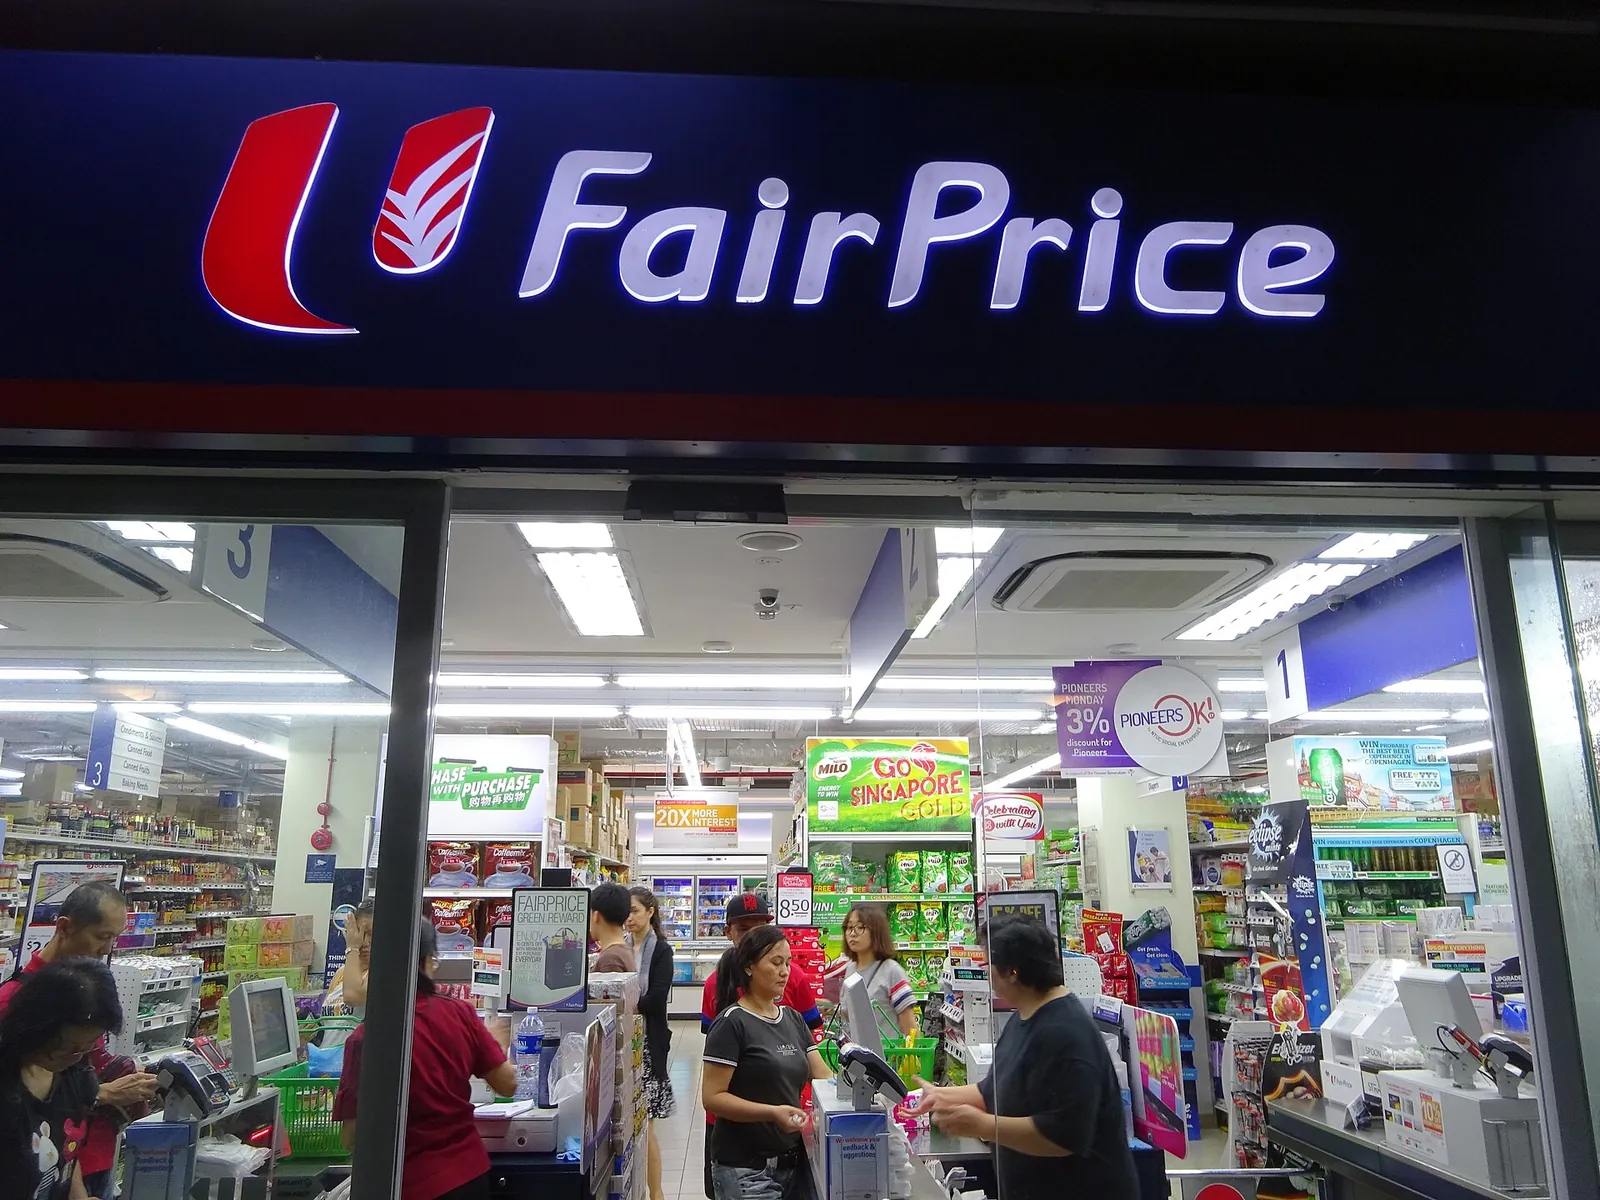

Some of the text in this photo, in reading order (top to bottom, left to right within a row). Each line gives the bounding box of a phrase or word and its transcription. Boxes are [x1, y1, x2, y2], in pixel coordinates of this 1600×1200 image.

[518, 149, 1336, 317] FairPrice
[1277, 649, 1291, 699] 1
[1062, 683, 1108, 694] PIONEERS
[1065, 695, 1105, 705] MONDAY
[1067, 707, 1110, 735] 3%
[1120, 707, 1184, 728] PIONEERS
[1066, 738, 1112, 748] discount for
[1359, 740, 1379, 748] WIN
[127, 744, 152, 758] Canned Food
[1074, 748, 1108, 757] Pioneers
[123, 760, 138, 773] Canned
[818, 762, 848, 775] MILO
[873, 757, 912, 778] GO
[93, 761, 103, 786] 3
[1392, 771, 1413, 779] FREE
[122, 778, 136, 790] Baking
[433, 784, 461, 795] WITH
[462, 775, 532, 797] PURCHASE
[850, 770, 963, 807] SINGAPORE
[900, 796, 968, 821] GOLD
[656, 808, 718, 827] 20X MORE
[691, 818, 737, 826] INTEREST
[996, 818, 1016, 829] with
[1249, 823, 1282, 847] eclipse
[518, 895, 586, 912] FAIRPRICE
[517, 912, 585, 923] GREEN REWARD
[516, 931, 543, 941] ENJOY
[1365, 1046, 1382, 1058] SPOON
[842, 1143, 869, 1151] eedback
[842, 1151, 877, 1160] uggestions
